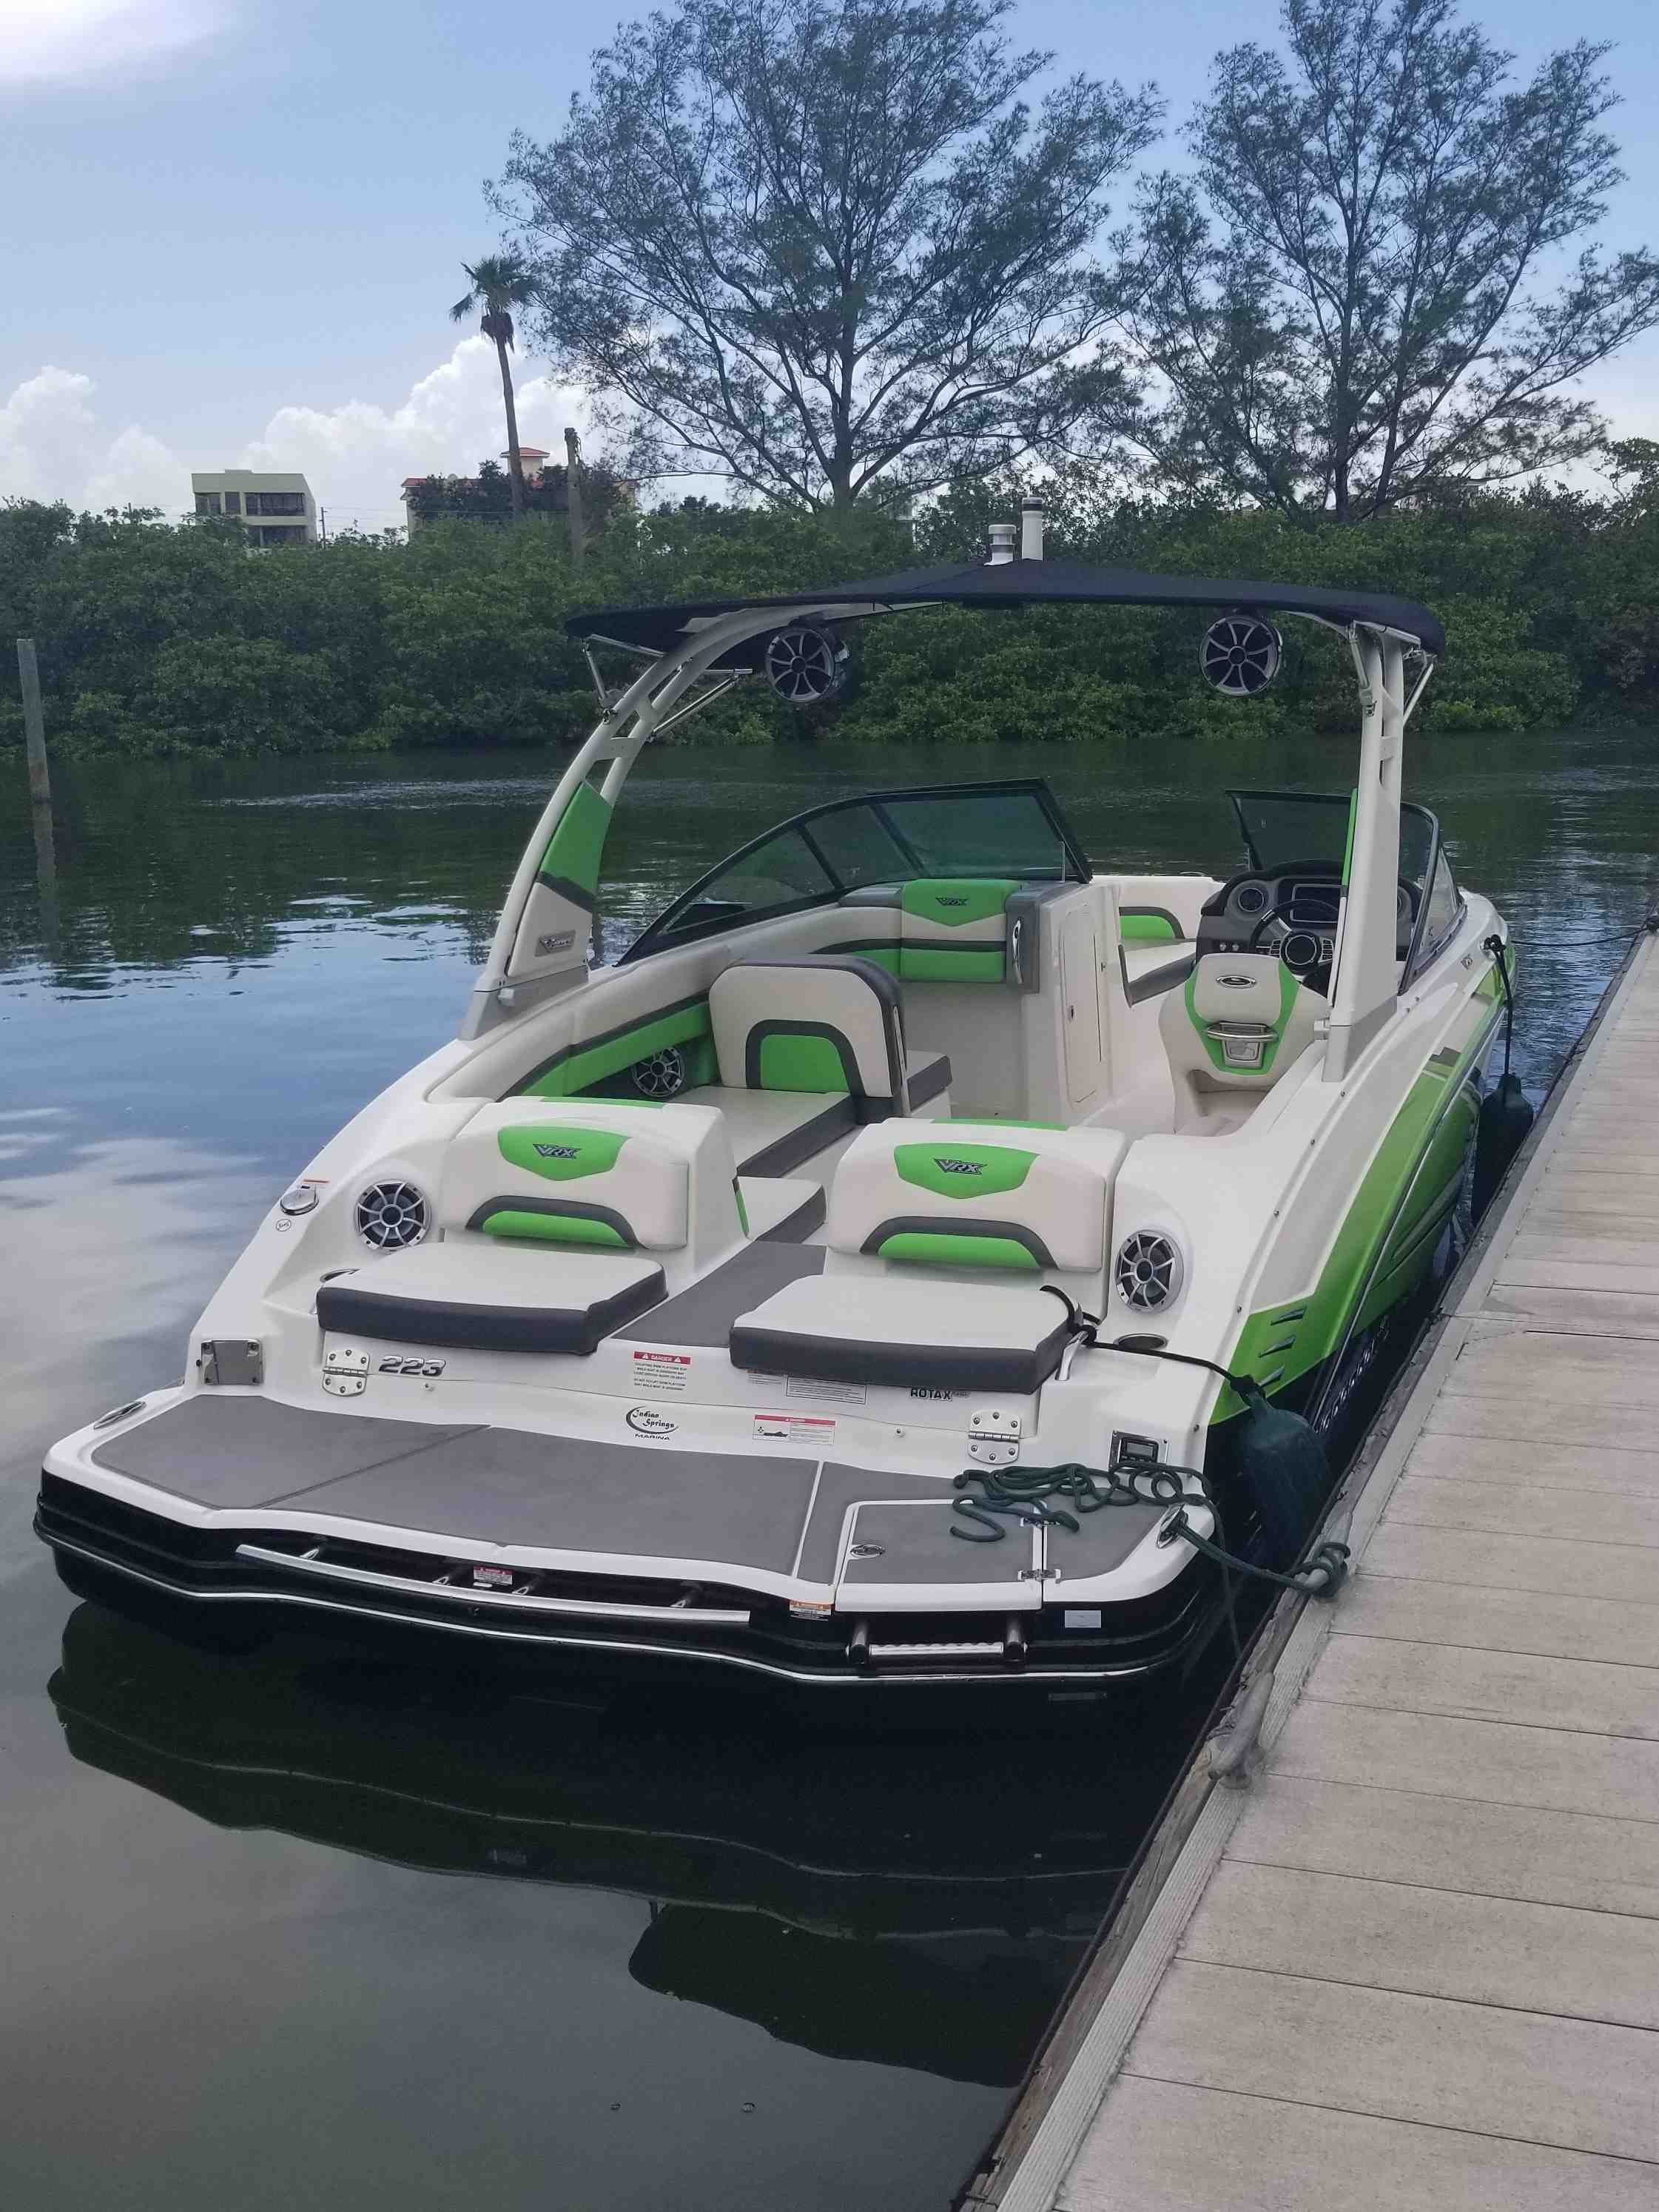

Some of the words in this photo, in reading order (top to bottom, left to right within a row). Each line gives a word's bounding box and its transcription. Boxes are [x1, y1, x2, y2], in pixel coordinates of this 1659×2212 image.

[533, 1143, 581, 1159] VRX
[934, 1159, 987, 1175] VRX
[378, 1355, 445, 1376] 223
[910, 1388, 952, 1400] ROTAX
[642, 1419, 675, 1430] Springs
